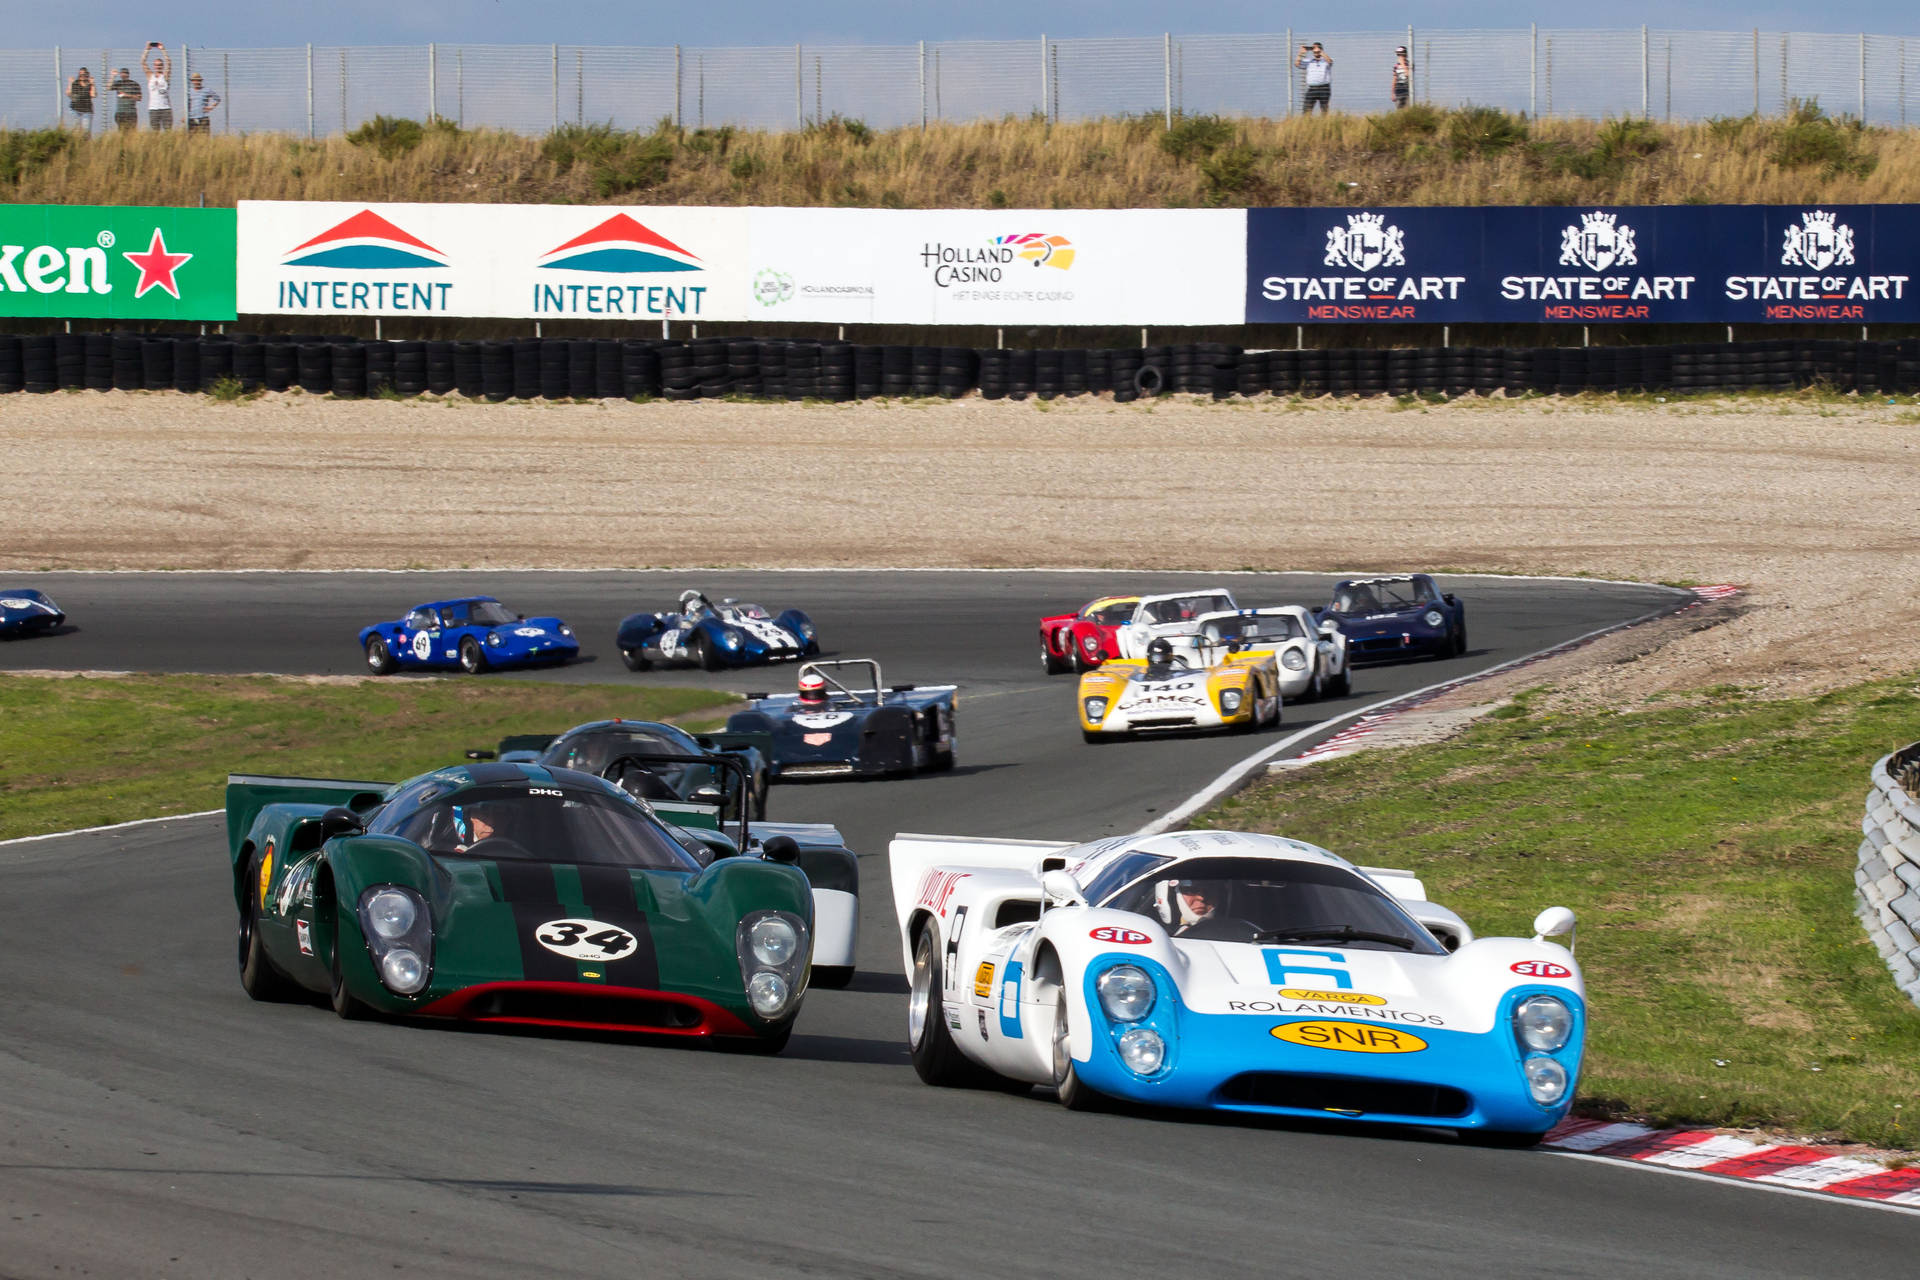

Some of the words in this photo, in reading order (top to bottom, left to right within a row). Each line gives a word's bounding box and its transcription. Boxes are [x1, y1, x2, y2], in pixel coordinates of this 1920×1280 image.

[279, 281, 453, 311] INTERTENT
[1262, 277, 1367, 300] STATE
[1368, 277, 1397, 292] OF
[1397, 277, 1466, 300] ART
[1501, 276, 1602, 300] STATE
[1603, 277, 1629, 291] OF
[1631, 277, 1695, 300] ART
[1725, 276, 1820, 300] STATE
[1822, 277, 1847, 291] OF
[1848, 276, 1909, 300] ART
[535, 283, 707, 314] INTERTENT
[1309, 305, 1415, 319] MENSWEAR
[1545, 305, 1649, 319] MENSWEAR
[1766, 305, 1864, 319] MENSWEAR
[1139, 681, 1195, 692] 140
[1117, 694, 1208, 711] CAMEL
[529, 788, 563, 797] DHG
[539, 922, 634, 955] 34
[1095, 926, 1147, 942] STP
[1515, 961, 1568, 976] STP
[1294, 990, 1372, 1004] VARGA
[1228, 1000, 1445, 1026] ROLAMENTOS
[1298, 1025, 1402, 1050] SNR
